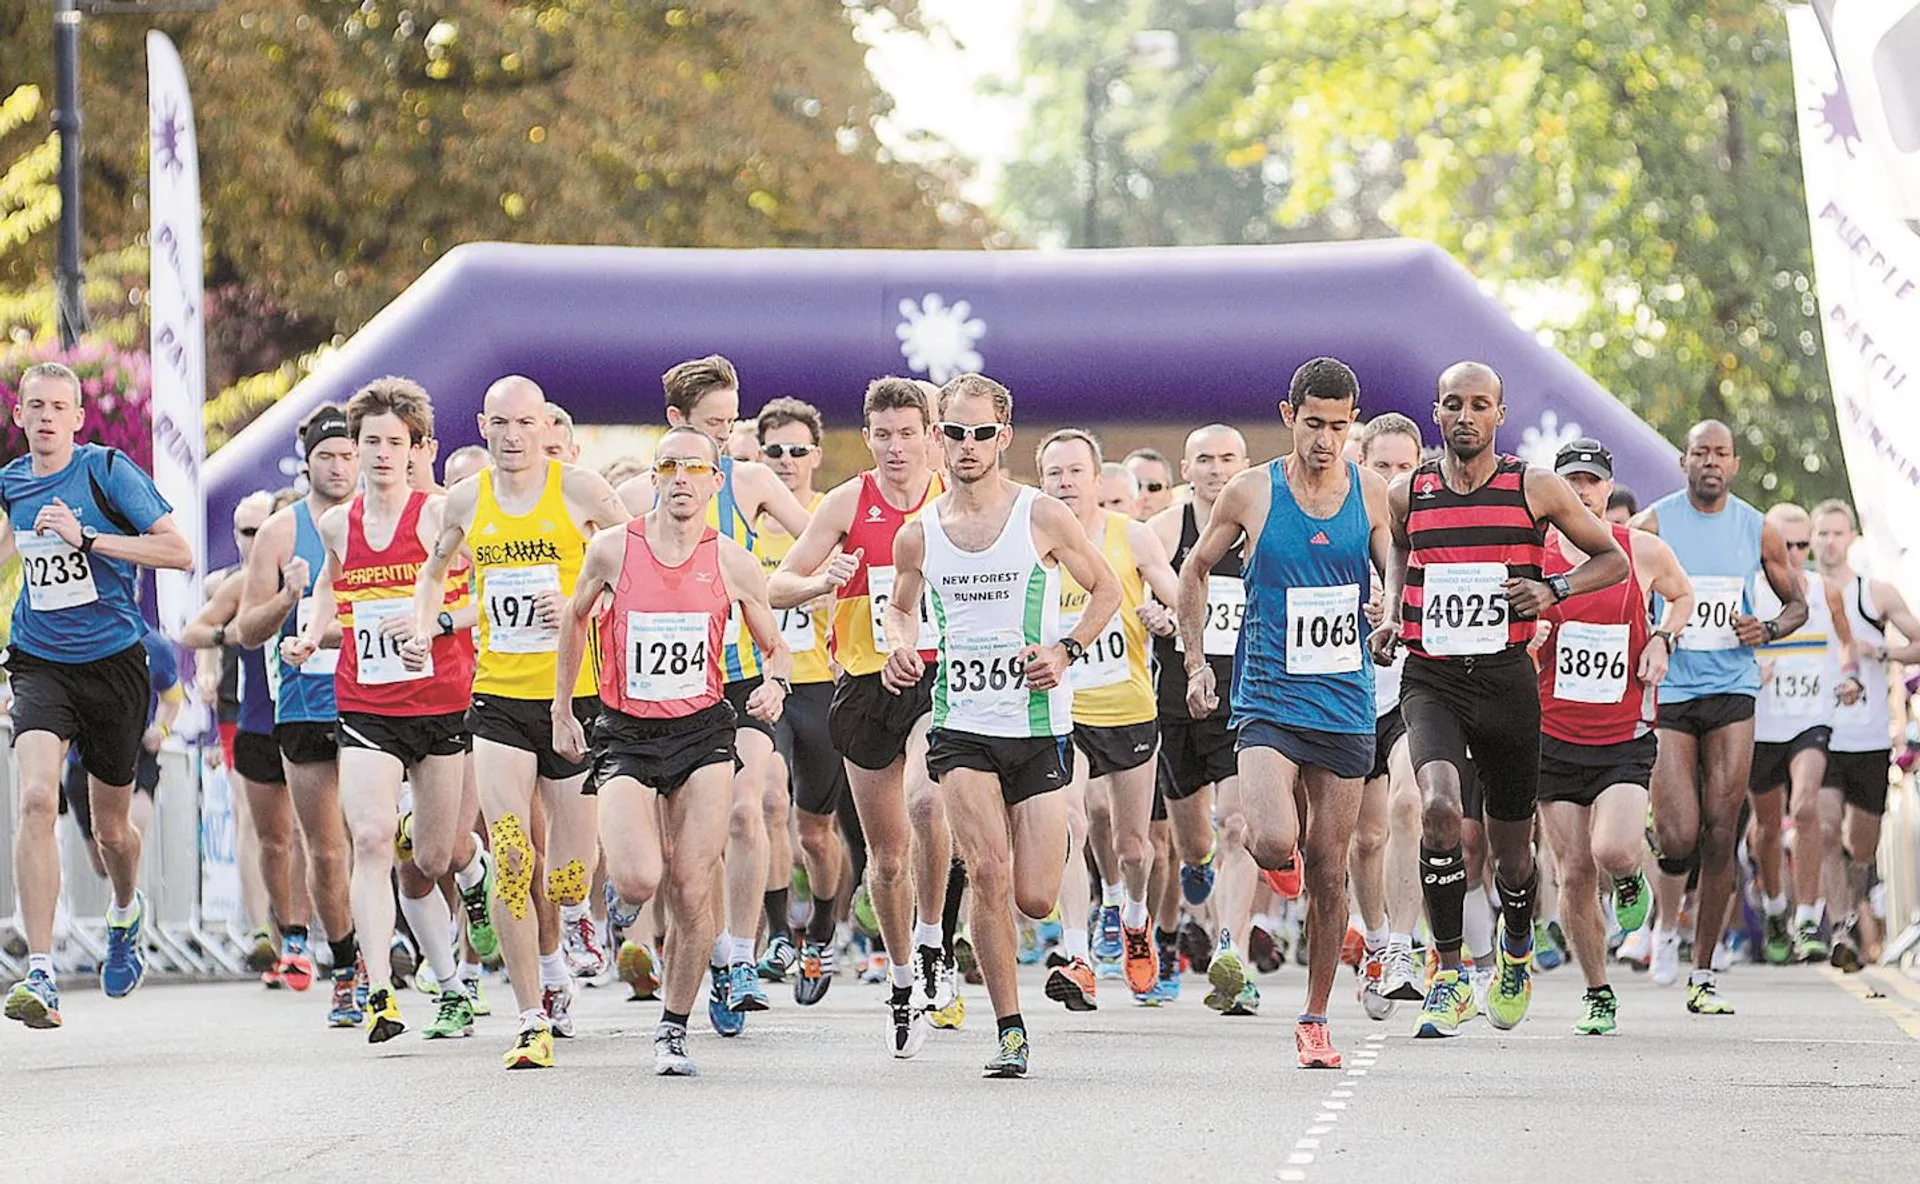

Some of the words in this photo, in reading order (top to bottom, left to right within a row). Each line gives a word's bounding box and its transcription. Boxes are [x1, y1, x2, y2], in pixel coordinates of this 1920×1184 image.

[25, 551, 88, 586] 2233
[942, 576, 970, 585] NEW
[973, 572, 1020, 584] FOREST
[954, 590, 1010, 602] RUNNERS
[1427, 594, 1505, 628] 4025
[1296, 612, 1356, 648] 1063
[636, 641, 705, 675] 1284
[950, 656, 1025, 692] 3369
[1560, 647, 1625, 680] 3896
[1776, 674, 1820, 697] 1356
[1438, 869, 1466, 885] asics
